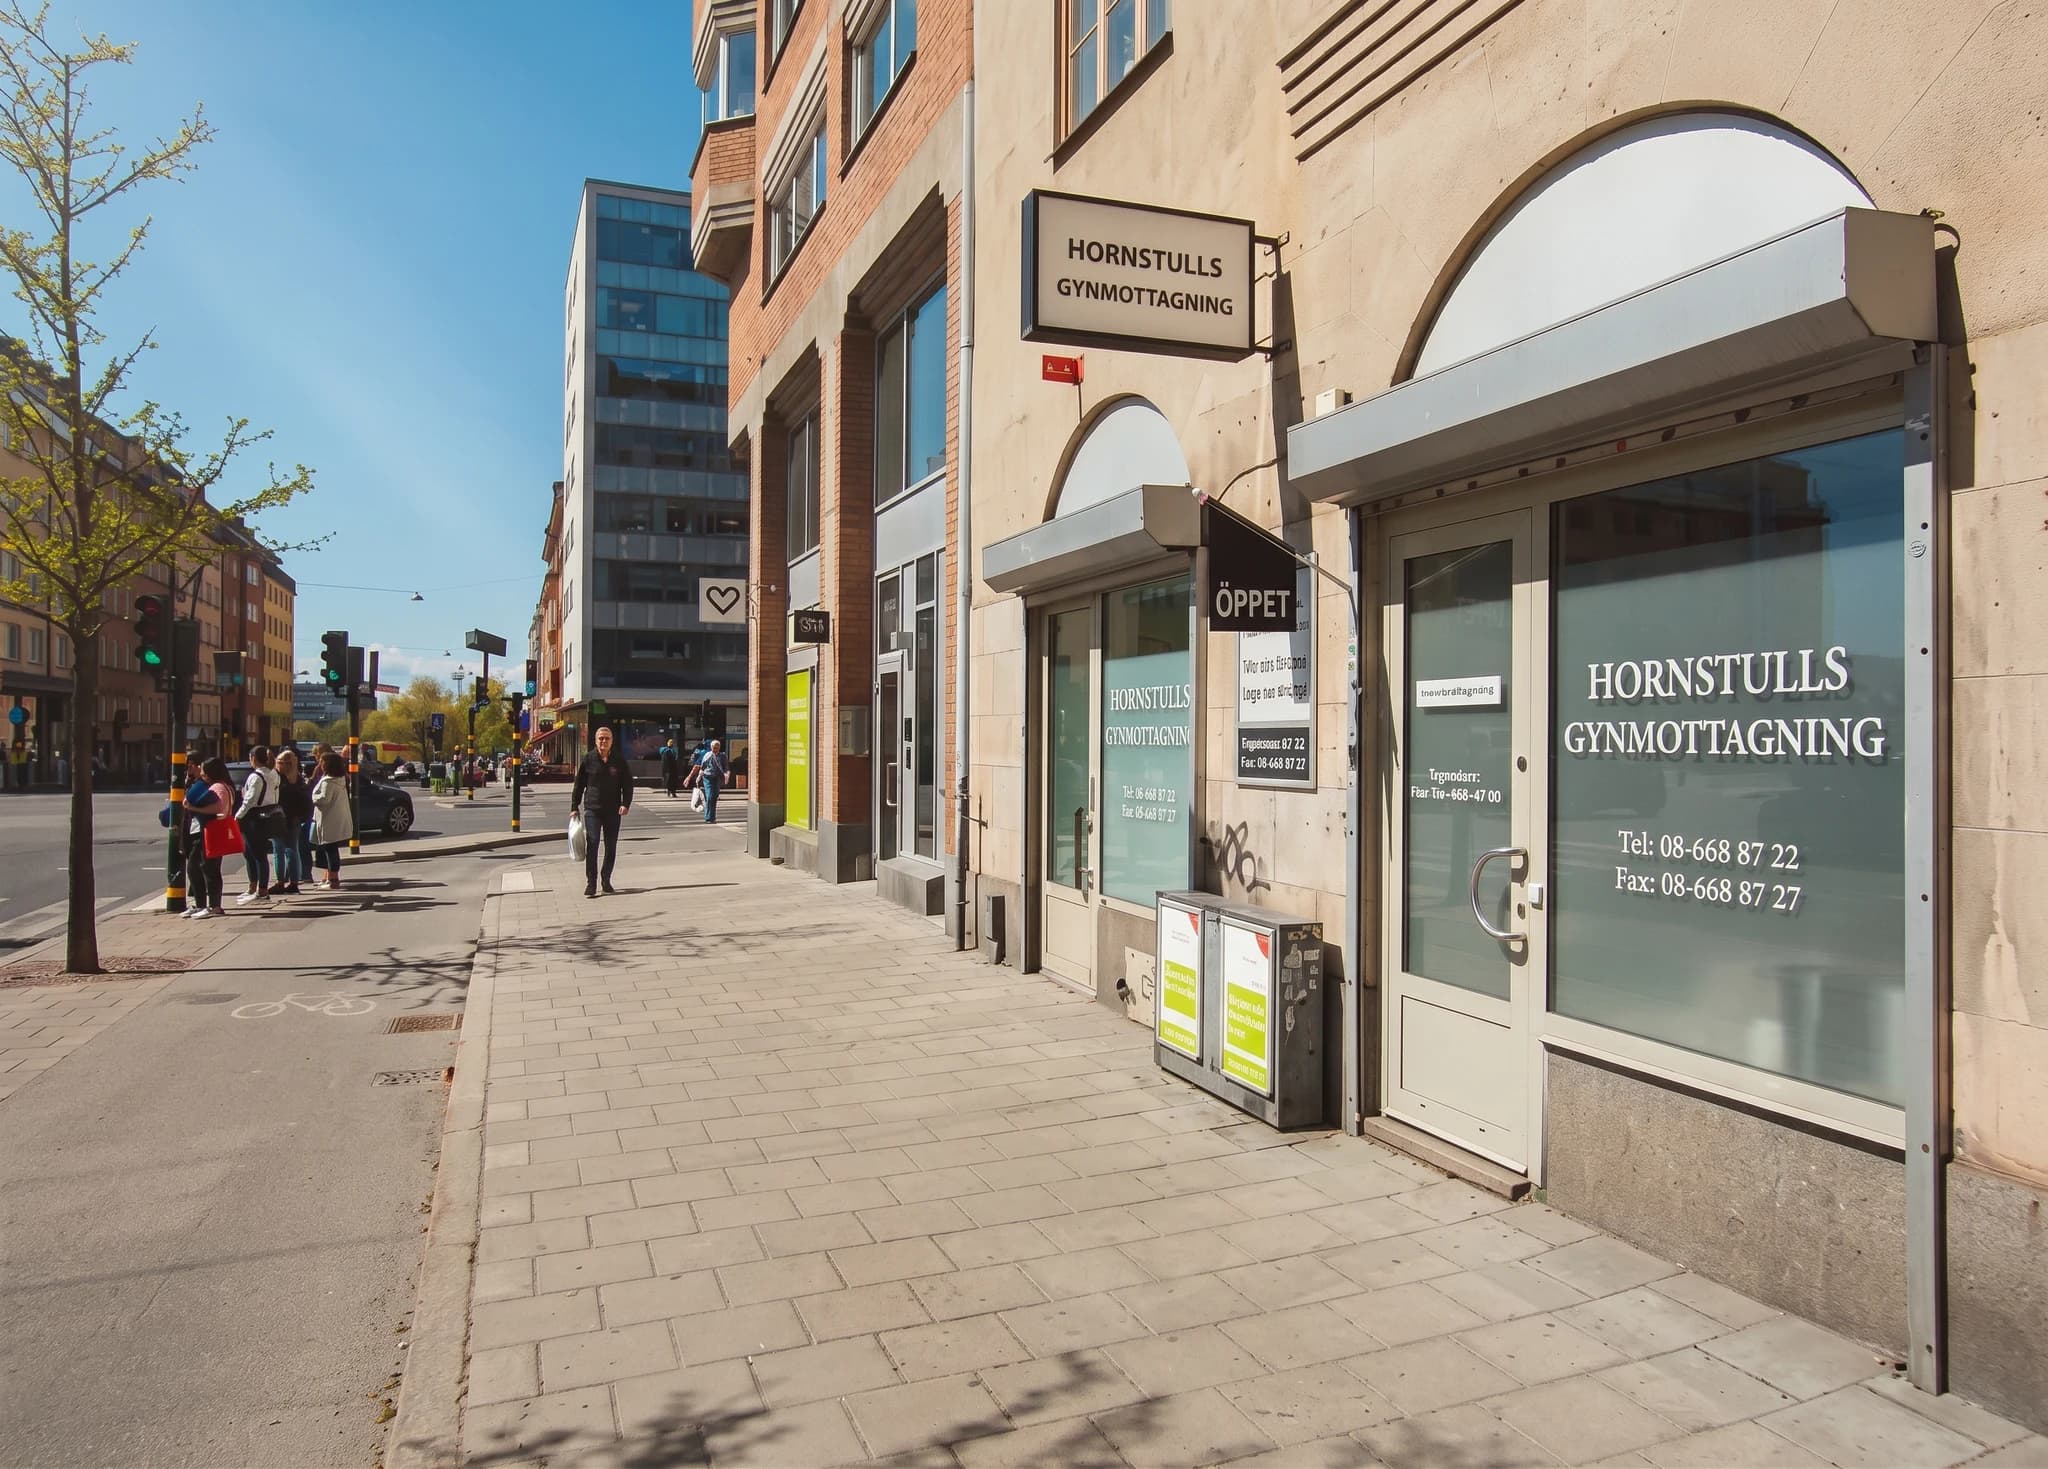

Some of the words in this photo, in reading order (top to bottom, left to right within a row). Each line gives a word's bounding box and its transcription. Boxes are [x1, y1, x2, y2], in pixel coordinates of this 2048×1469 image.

[1068, 237, 1223, 278] HORNSTULLS
[1056, 278, 1233, 316] GYNMOTTAGNING
[1215, 580, 1291, 618] ÖPPET
[1587, 646, 1849, 700] HORNSTULLS
[1110, 684, 1191, 711] HORNSTULLS
[1294, 737, 1305, 750] 22
[1563, 716, 1886, 758] GYNMOTTAGNING
[1617, 830, 1654, 856] Tel:
[1659, 834, 1731, 864] 08-668
[1737, 840, 1765, 867] 87
[1770, 843, 1800, 870] 22
[1615, 866, 1656, 894] Fax:
[1661, 872, 1732, 903] 08-668
[1738, 880, 1766, 907] 87
[1772, 884, 1801, 911] 27
